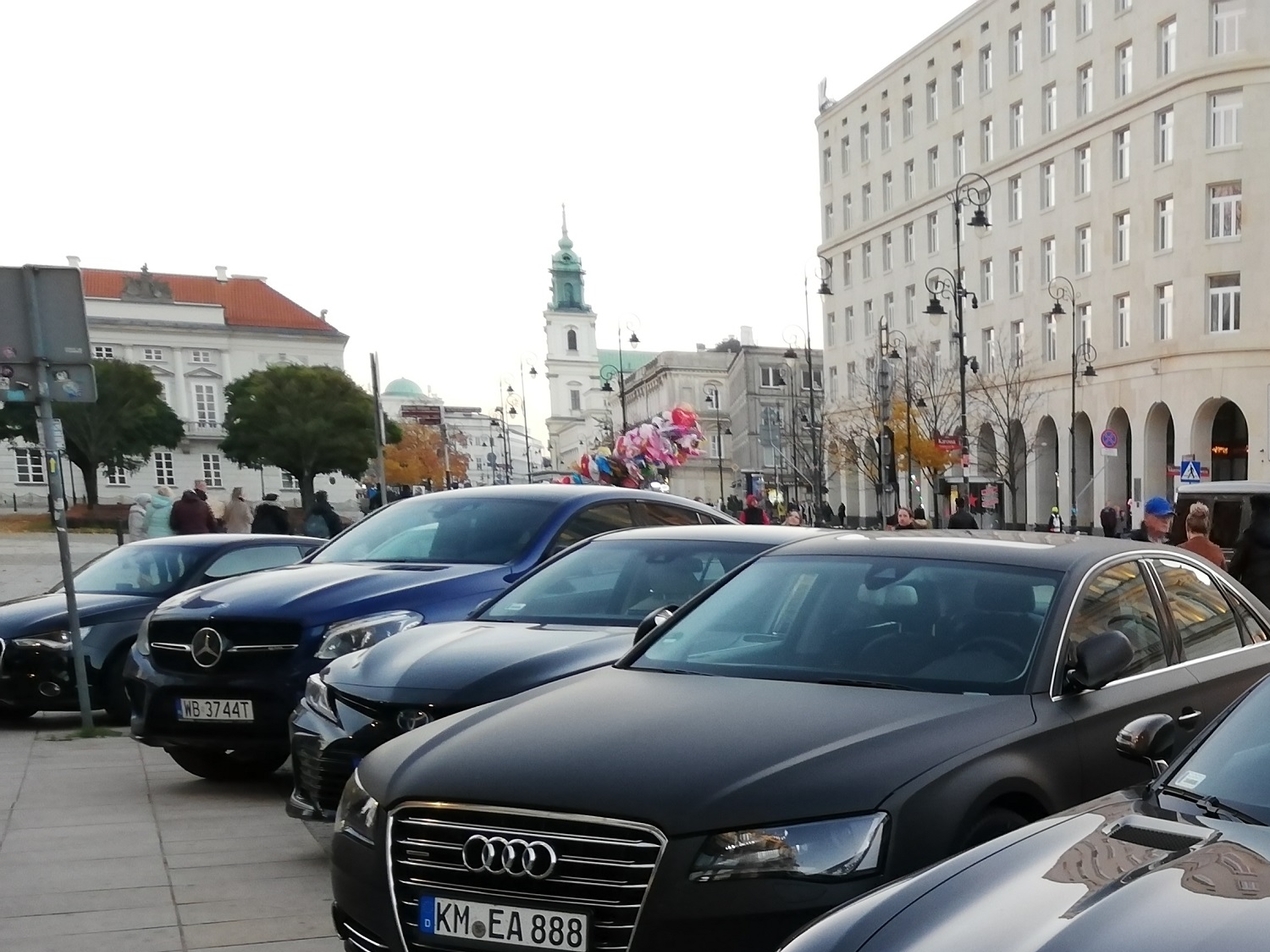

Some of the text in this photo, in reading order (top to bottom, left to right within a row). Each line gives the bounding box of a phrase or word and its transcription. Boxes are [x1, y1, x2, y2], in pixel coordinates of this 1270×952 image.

[183, 700, 249, 718] WB 3744T
[424, 918, 431, 928] D
[436, 901, 583, 948] KM EA 888
